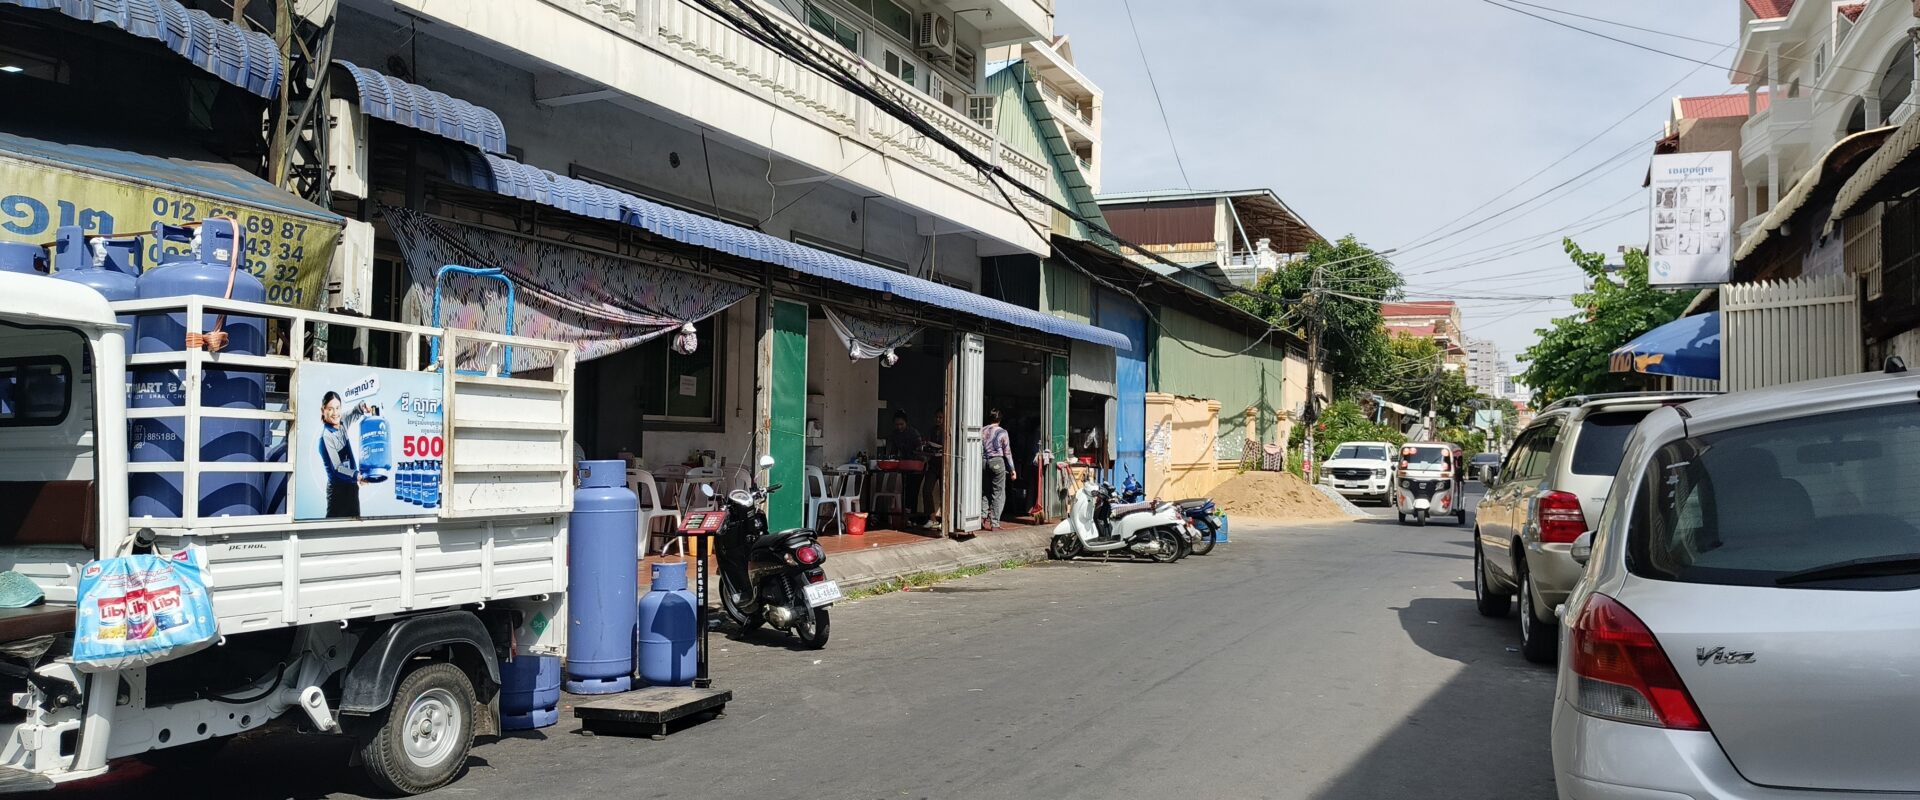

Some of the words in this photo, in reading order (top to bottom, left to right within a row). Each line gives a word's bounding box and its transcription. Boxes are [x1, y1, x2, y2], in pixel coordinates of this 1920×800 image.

[152, 196, 196, 221] 012
[246, 215, 274, 236] 69
[281, 222, 308, 241] 87
[247, 237, 271, 257] 43
[278, 243, 304, 262] 34
[273, 264, 299, 282] 32
[268, 284, 303, 304] 001
[101, 604, 127, 619] Liby
[129, 600, 148, 616] iby
[152, 595, 180, 611] Liby
